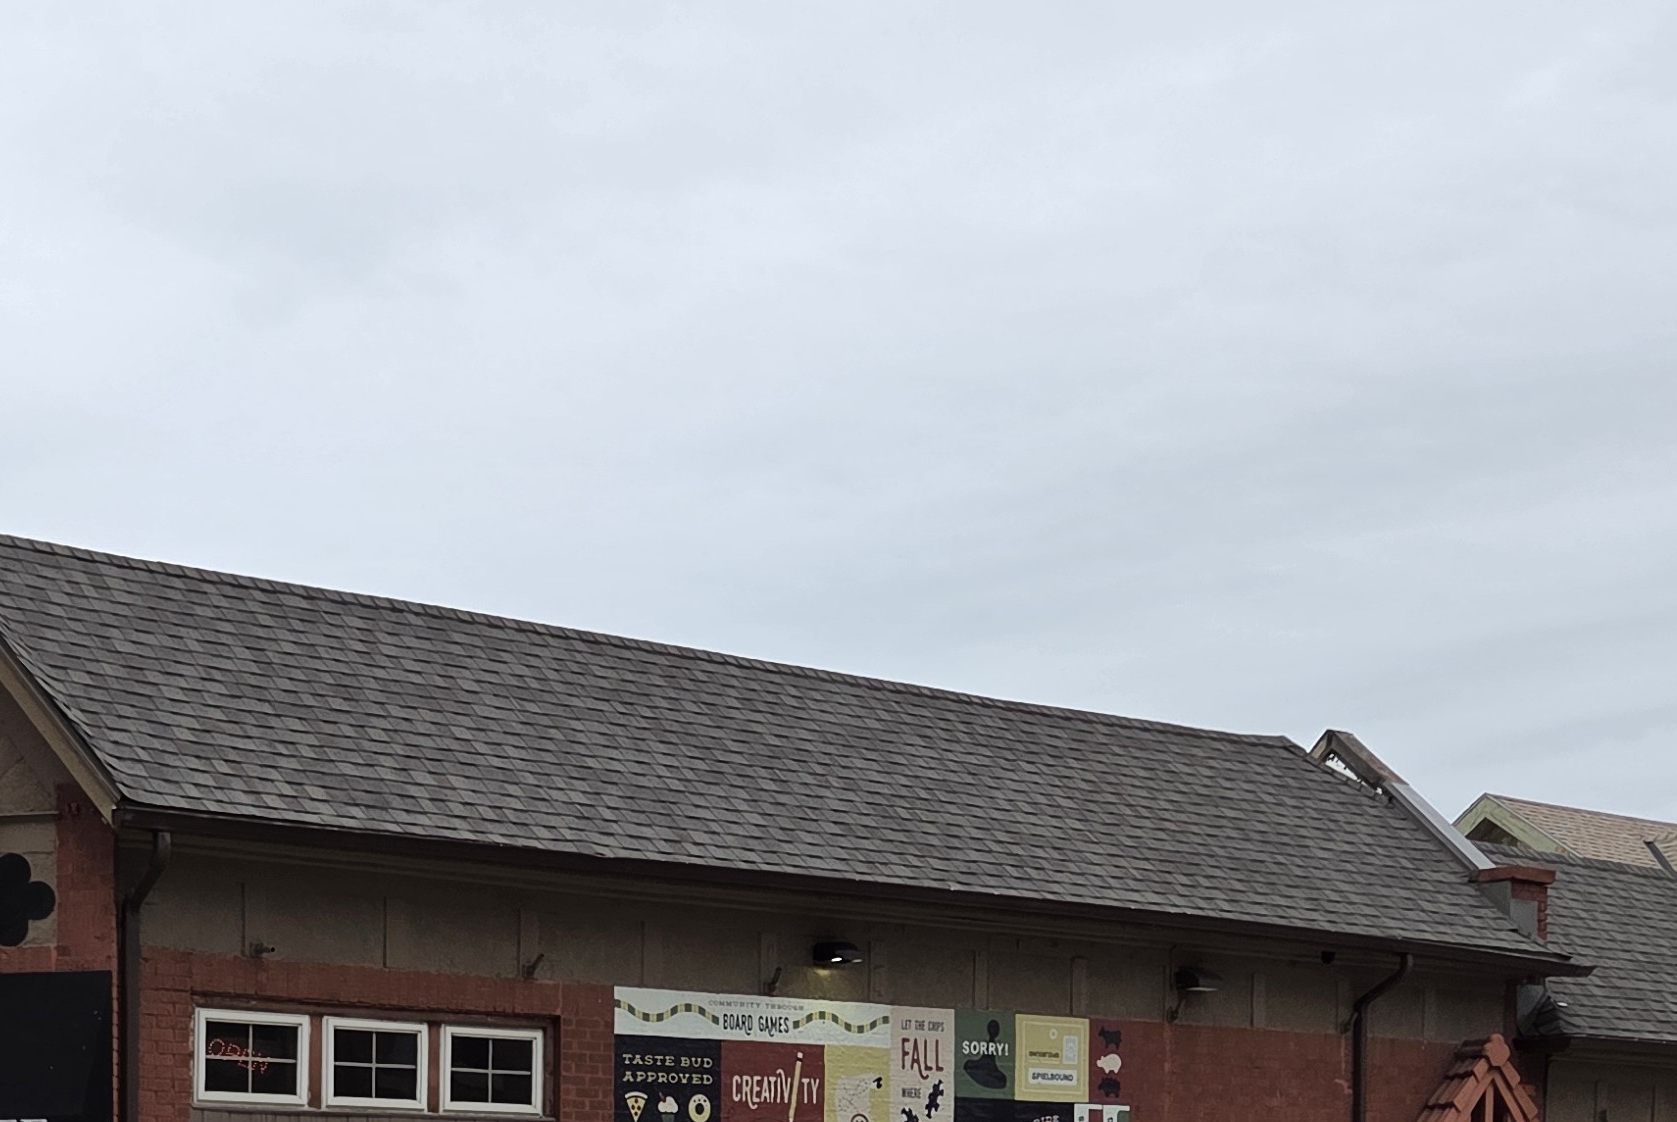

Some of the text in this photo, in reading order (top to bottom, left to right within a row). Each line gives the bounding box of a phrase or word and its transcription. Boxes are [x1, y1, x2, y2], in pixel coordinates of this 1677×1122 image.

[722, 1013, 790, 1037] BOARD GAMES
[901, 1019, 945, 1032] LET THE CHIPS
[962, 1040, 1009, 1056] SORRY!
[622, 1053, 714, 1069] TASTE BUD
[901, 1037, 944, 1080] FALL
[622, 1071, 714, 1085] APPROVED
[901, 1087, 922, 1100] WHERE
